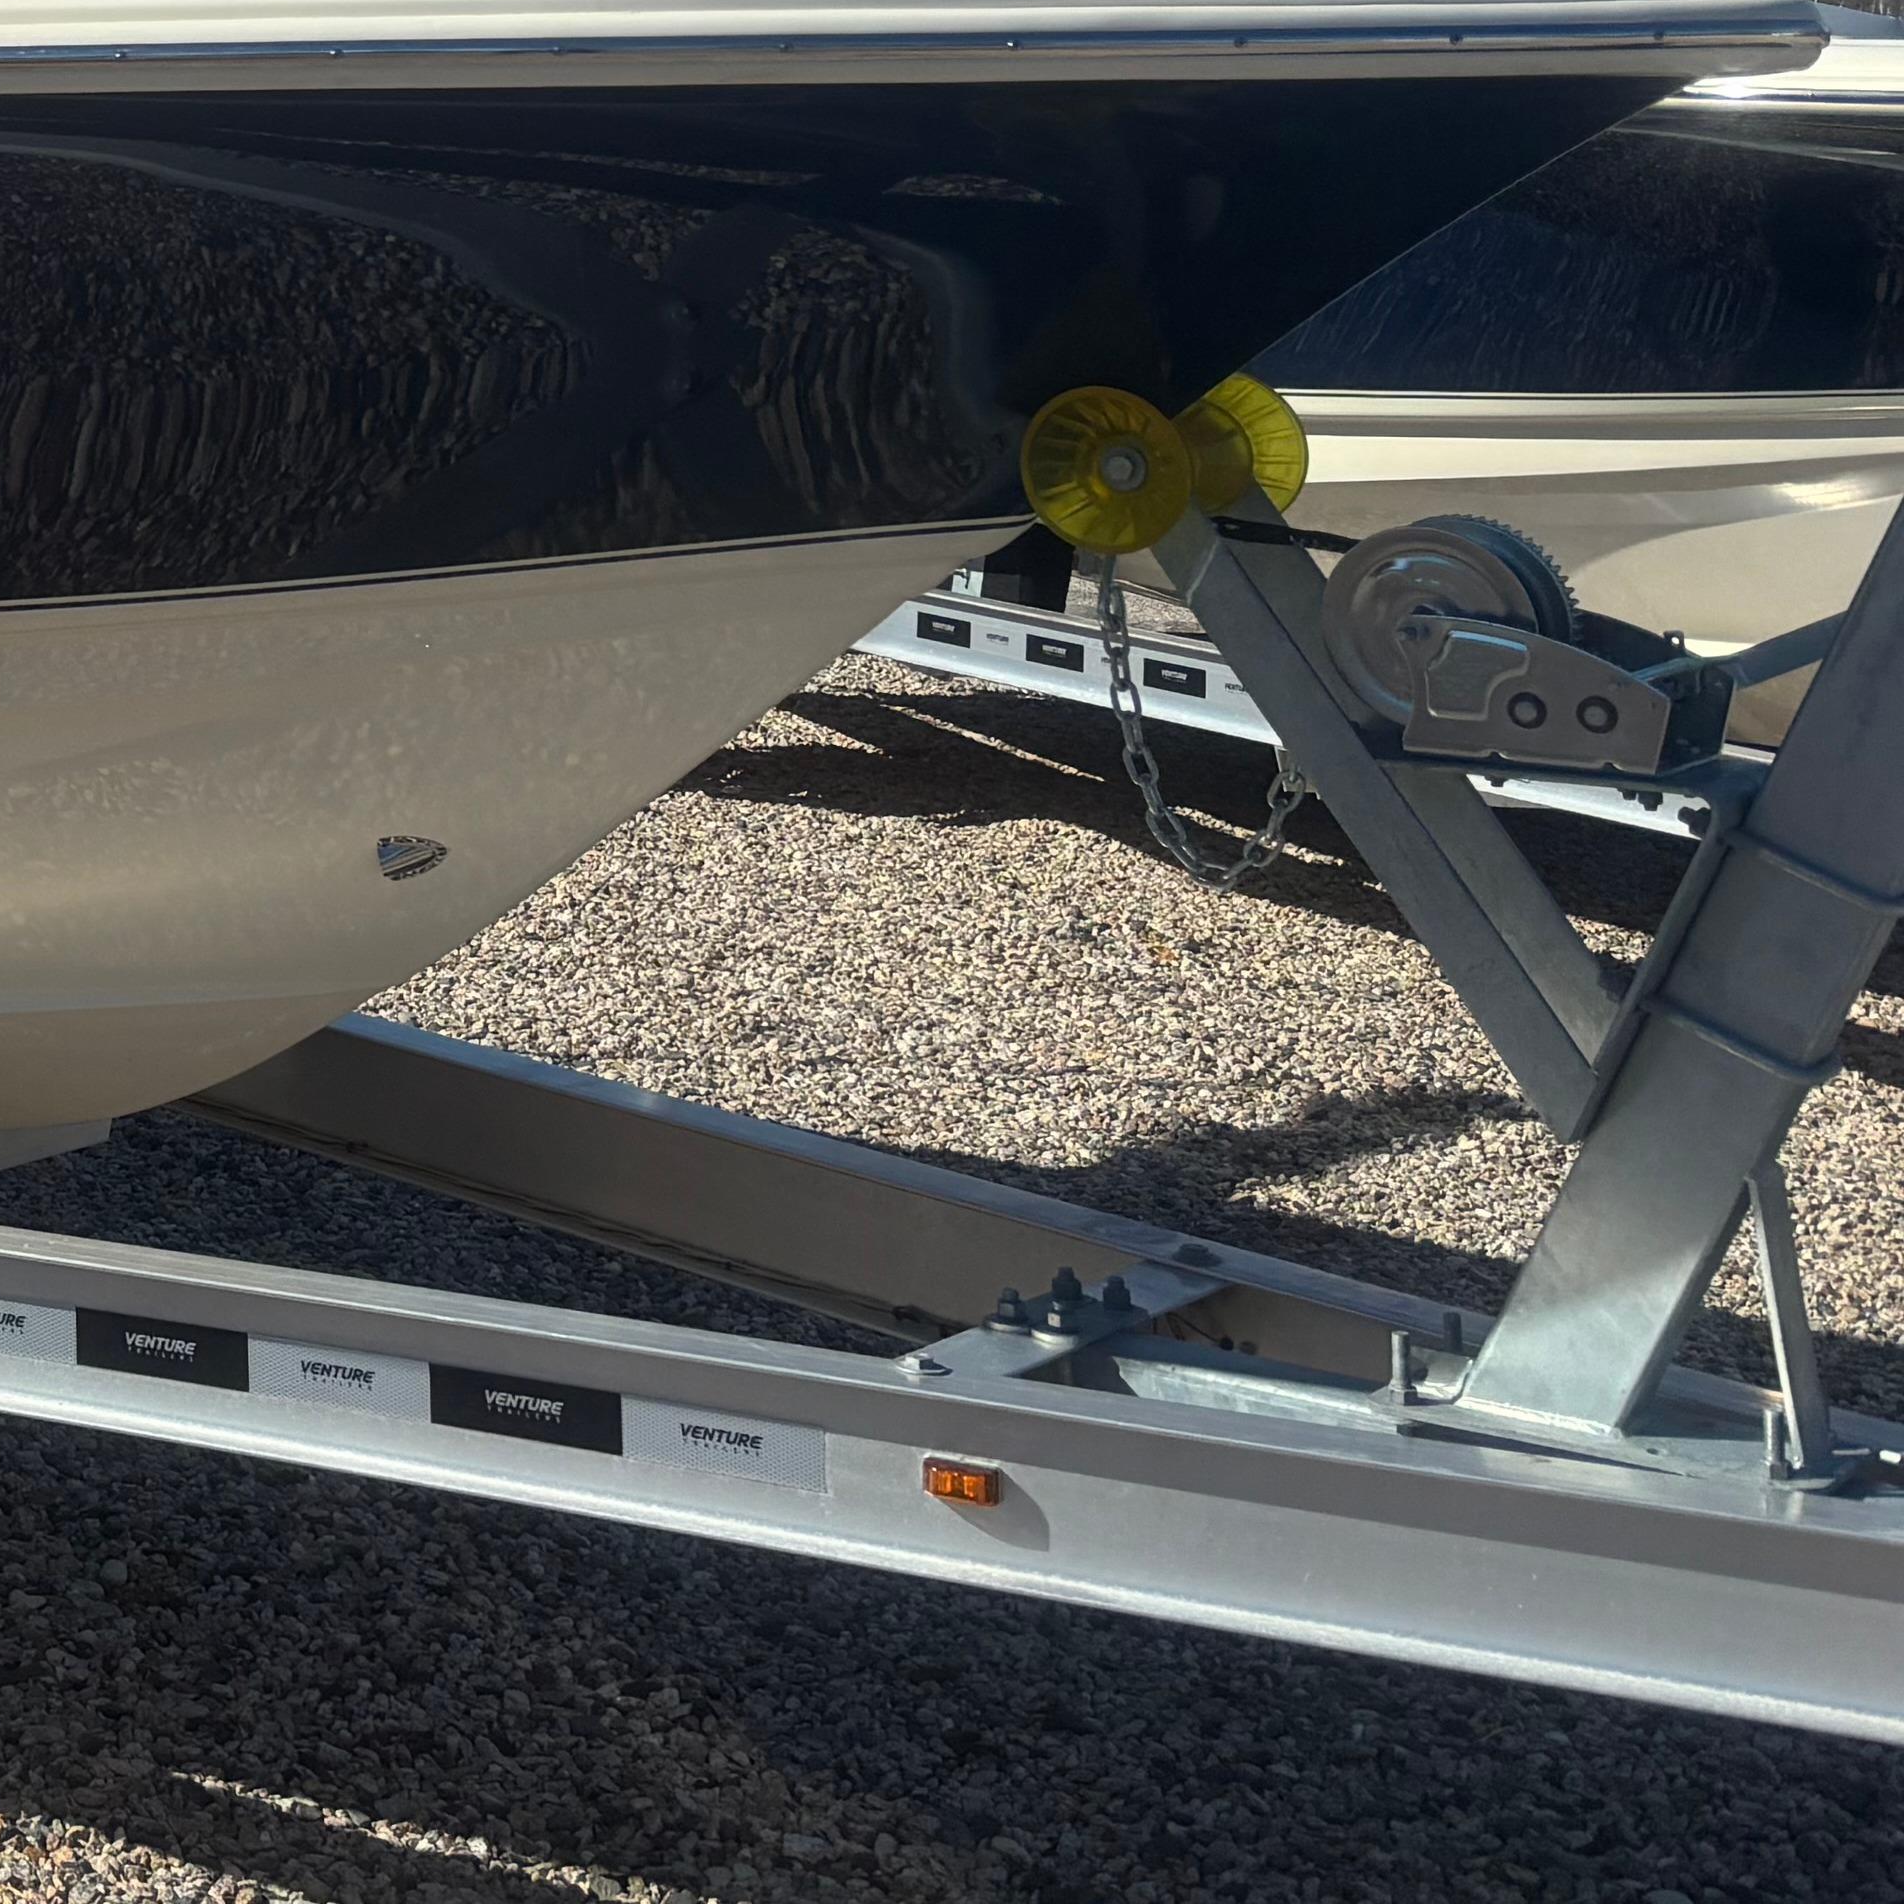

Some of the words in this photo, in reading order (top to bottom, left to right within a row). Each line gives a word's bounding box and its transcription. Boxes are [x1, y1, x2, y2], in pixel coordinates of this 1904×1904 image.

[125, 1331, 196, 1356] VENTURE
[301, 1360, 375, 1384] VENTURE
[485, 1389, 564, 1416] VENTURE
[680, 1423, 763, 1449] VENTURE
